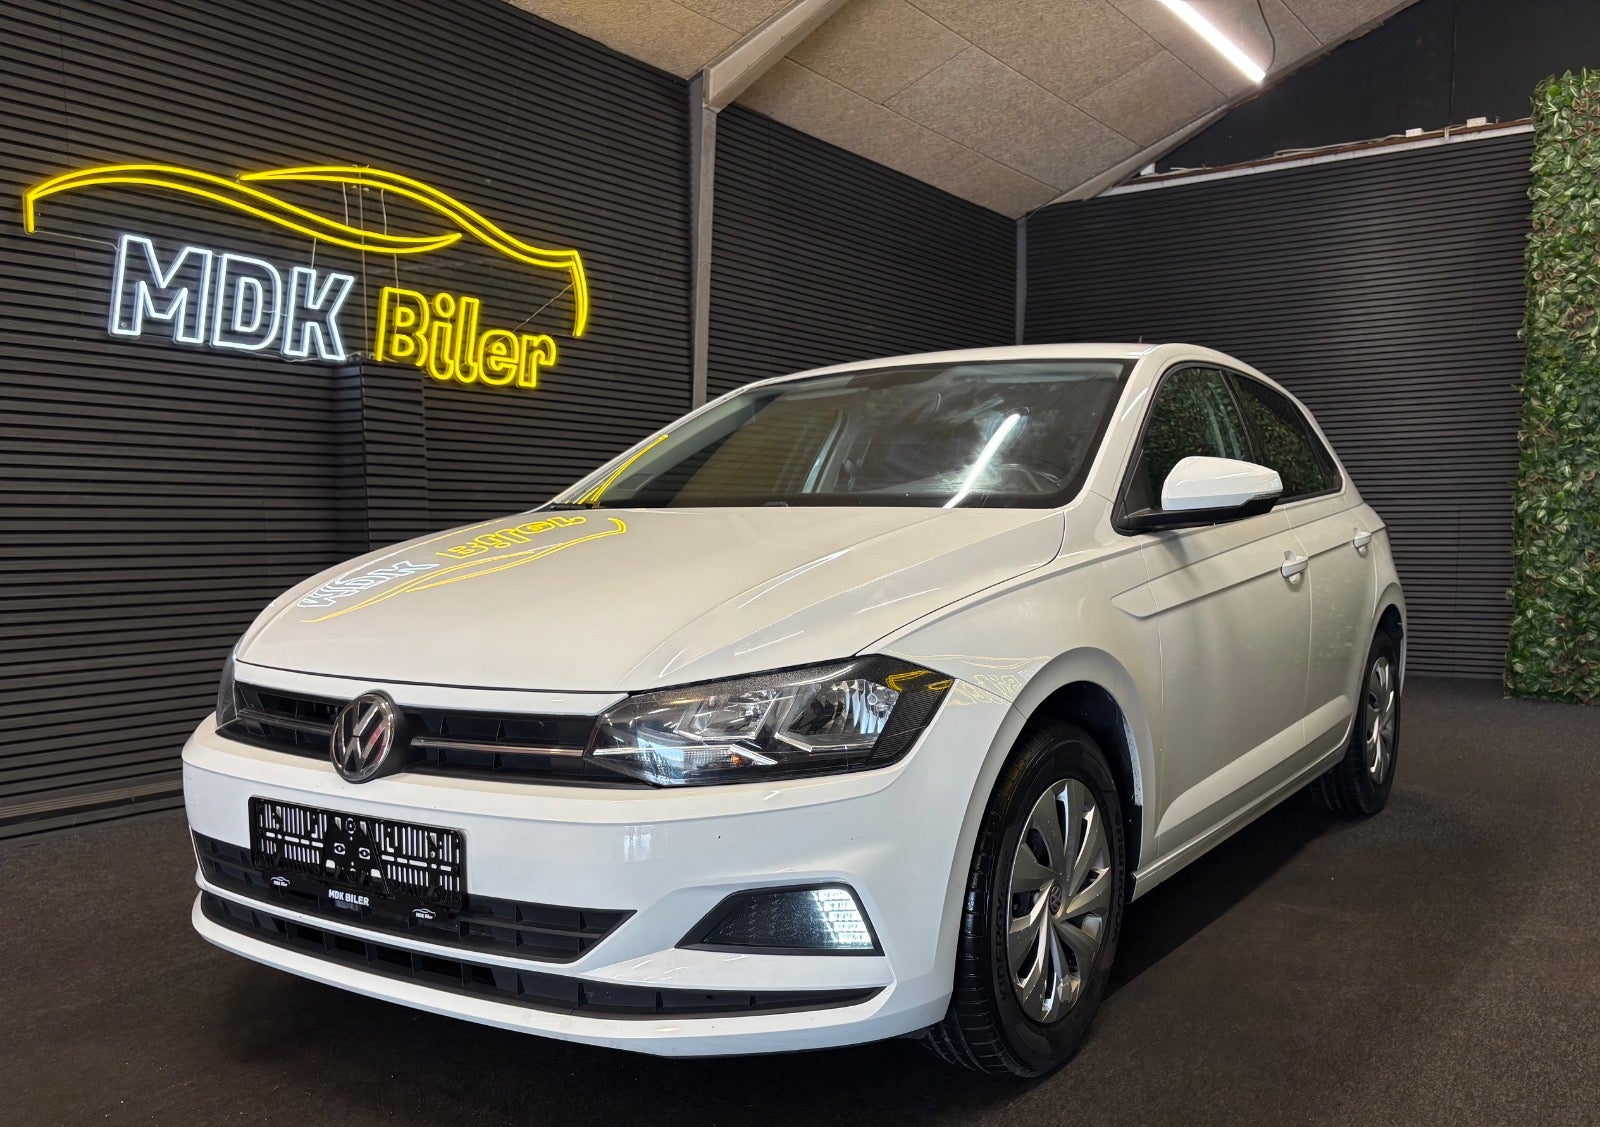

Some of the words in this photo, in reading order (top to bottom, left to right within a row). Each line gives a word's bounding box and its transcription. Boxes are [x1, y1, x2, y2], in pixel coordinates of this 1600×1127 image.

[109, 233, 356, 362] MDK
[375, 286, 556, 389] Biler
[328, 889, 345, 900] MDK
[345, 893, 370, 906] BILER
